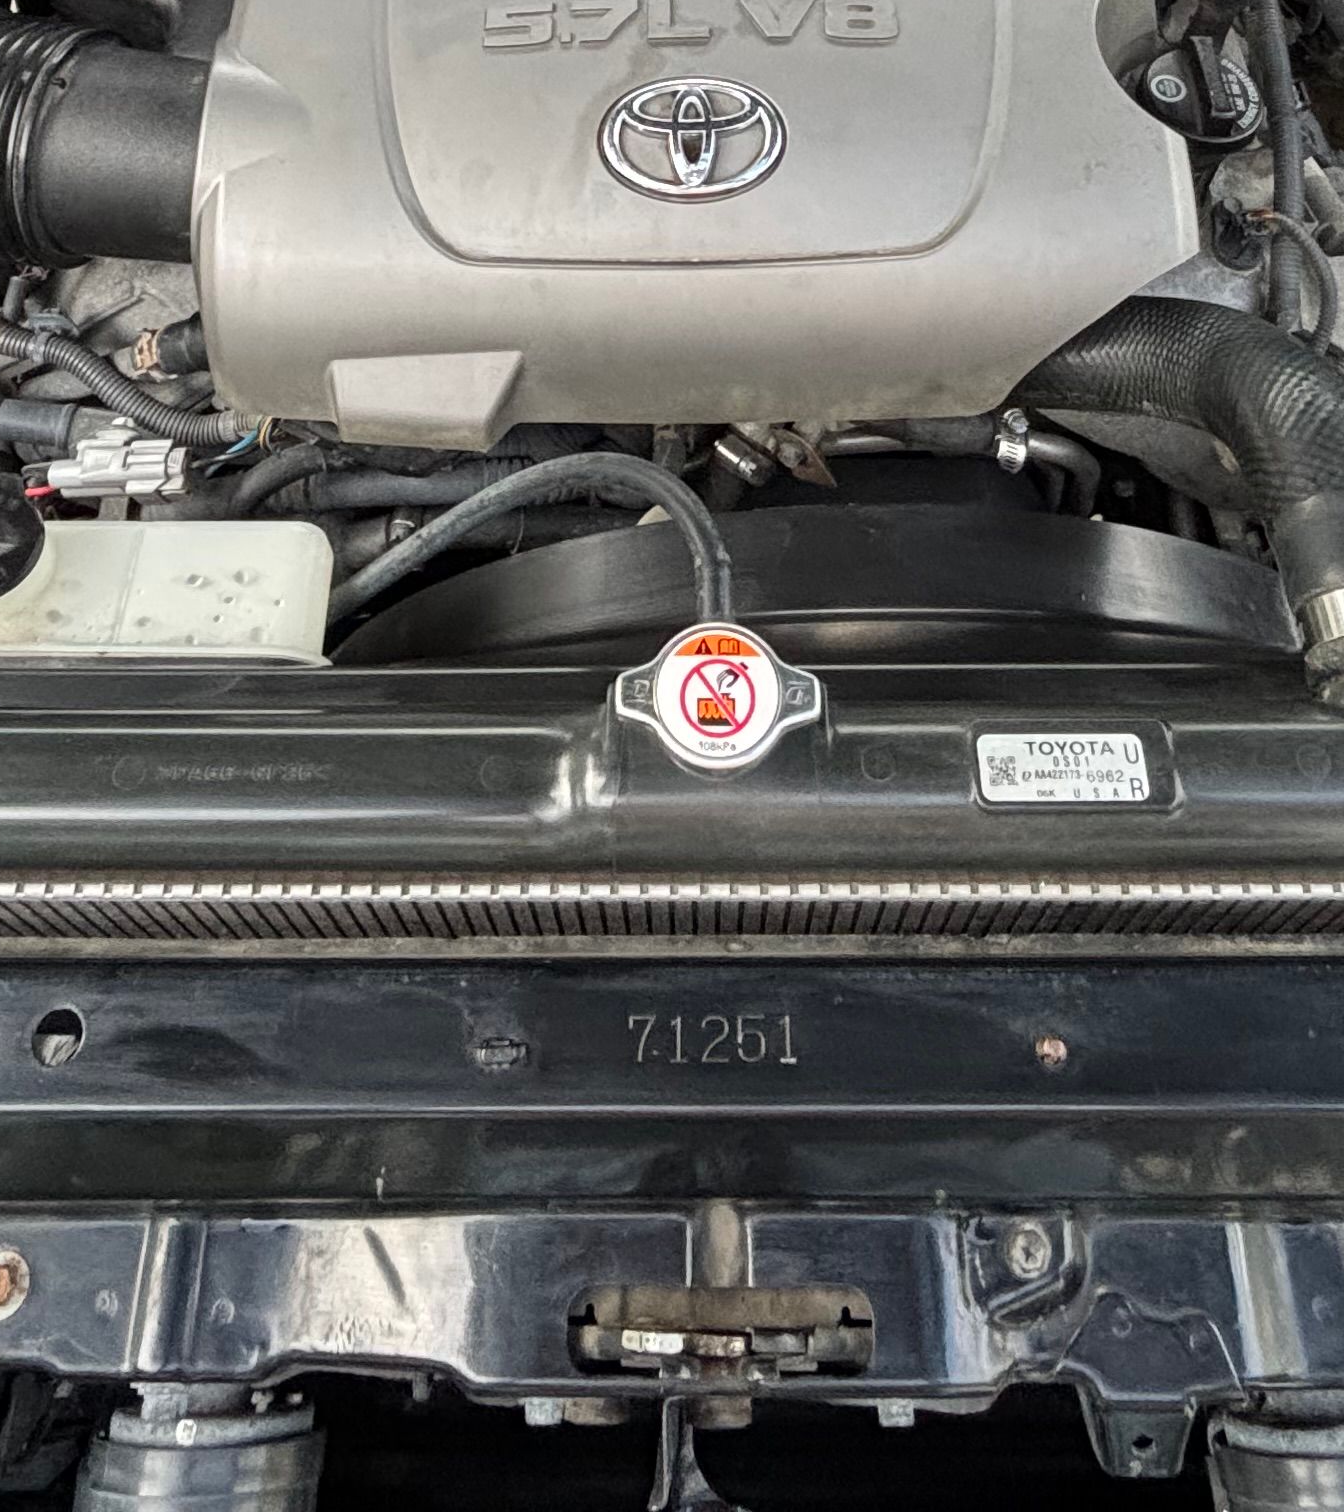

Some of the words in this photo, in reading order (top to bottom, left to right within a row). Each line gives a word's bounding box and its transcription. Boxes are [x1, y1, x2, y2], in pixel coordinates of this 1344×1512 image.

[699, 740, 737, 752] 108kPa
[1024, 740, 1115, 756] TOYOTA
[1123, 743, 1140, 764] U
[1130, 778, 1145, 799] R
[628, 1014, 798, 1064] 71251
